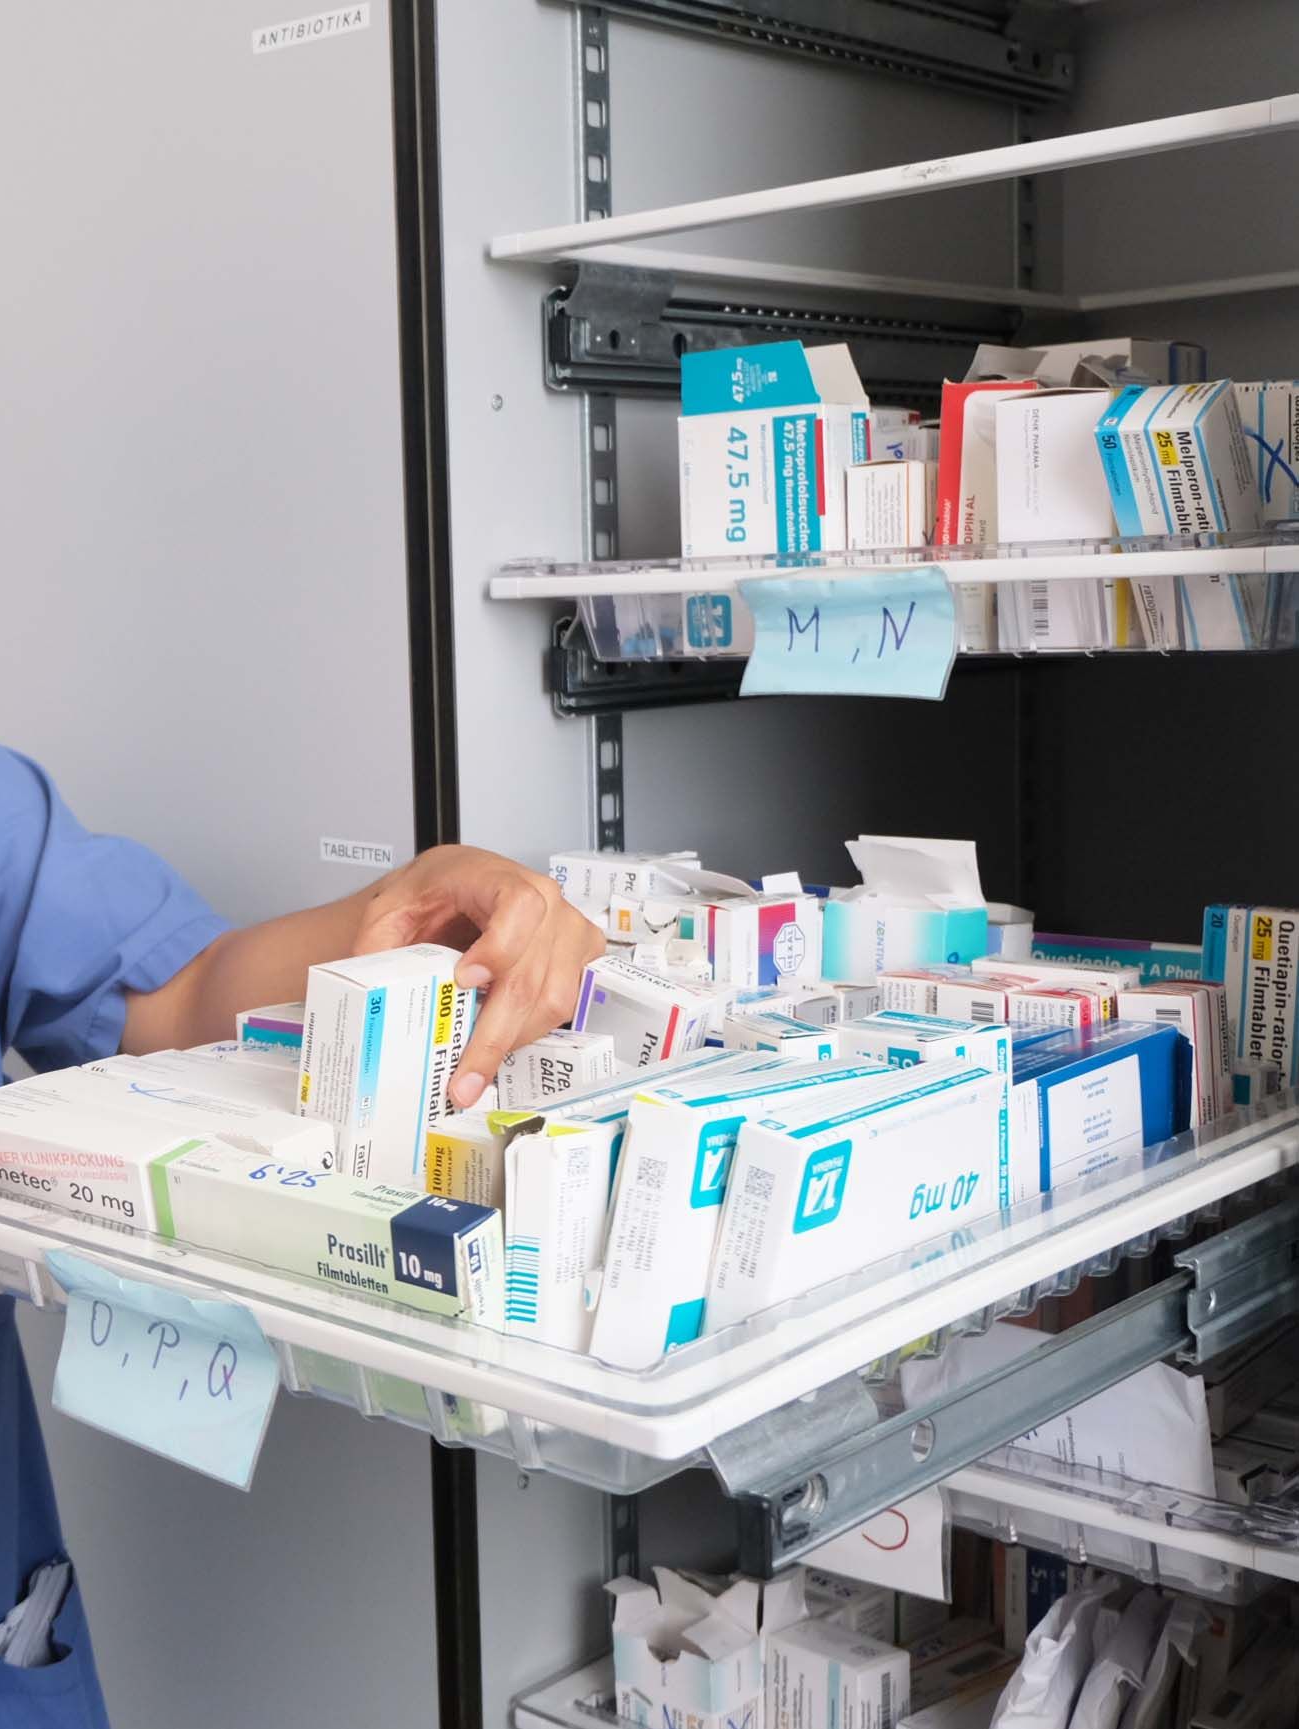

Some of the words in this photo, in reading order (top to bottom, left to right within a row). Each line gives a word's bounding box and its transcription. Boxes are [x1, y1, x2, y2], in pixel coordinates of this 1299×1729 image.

[258, 10, 364, 48] ANTIBIOTIKA
[782, 421, 795, 452] 47,5
[1032, 434, 1040, 469] PHARMA
[1102, 434, 1117, 449] 50
[1156, 432, 1173, 448] 25
[726, 427, 750, 489] 47,5
[783, 455, 794, 478] mg
[1160, 449, 1174, 466] mg
[965, 494, 975, 510] AL
[725, 499, 748, 543] mg
[963, 512, 974, 544] DIPIN
[323, 842, 392, 863] TABLETTEN
[555, 865, 567, 883] 50
[1211, 913, 1224, 928] 20
[1256, 917, 1273, 938] 25
[786, 929, 794, 969] HEXAL
[876, 919, 886, 971] ZENTIVA
[1253, 941, 1267, 961] mg
[1150, 963, 1161, 977] A
[1164, 964, 1200, 980] Phar
[369, 996, 382, 1015] 30
[439, 983, 455, 1018] 800
[1249, 966, 1271, 1060] Filmtablet
[1271, 920, 1295, 1085] Quetiapin-ratio
[303, 1011, 316, 1073] Filmtabletten
[434, 1022, 448, 1045] mg
[427, 1049, 448, 1126] Filmtab
[540, 1057, 556, 1096] GALE
[22, 1152, 126, 1168] KLINIKPACKUNG
[355, 1144, 367, 1178] ratio
[434, 1146, 445, 1168] mg
[431, 1168, 443, 1192] 100
[950, 1170, 980, 1212] 40
[69, 1182, 94, 1203] 20
[101, 1192, 135, 1217] mg
[426, 1196, 448, 1207] 10
[909, 1181, 946, 1221] mg
[317, 1262, 389, 1294] Filmtabletten
[399, 1251, 421, 1278] 10
[423, 1267, 443, 1289] mg
